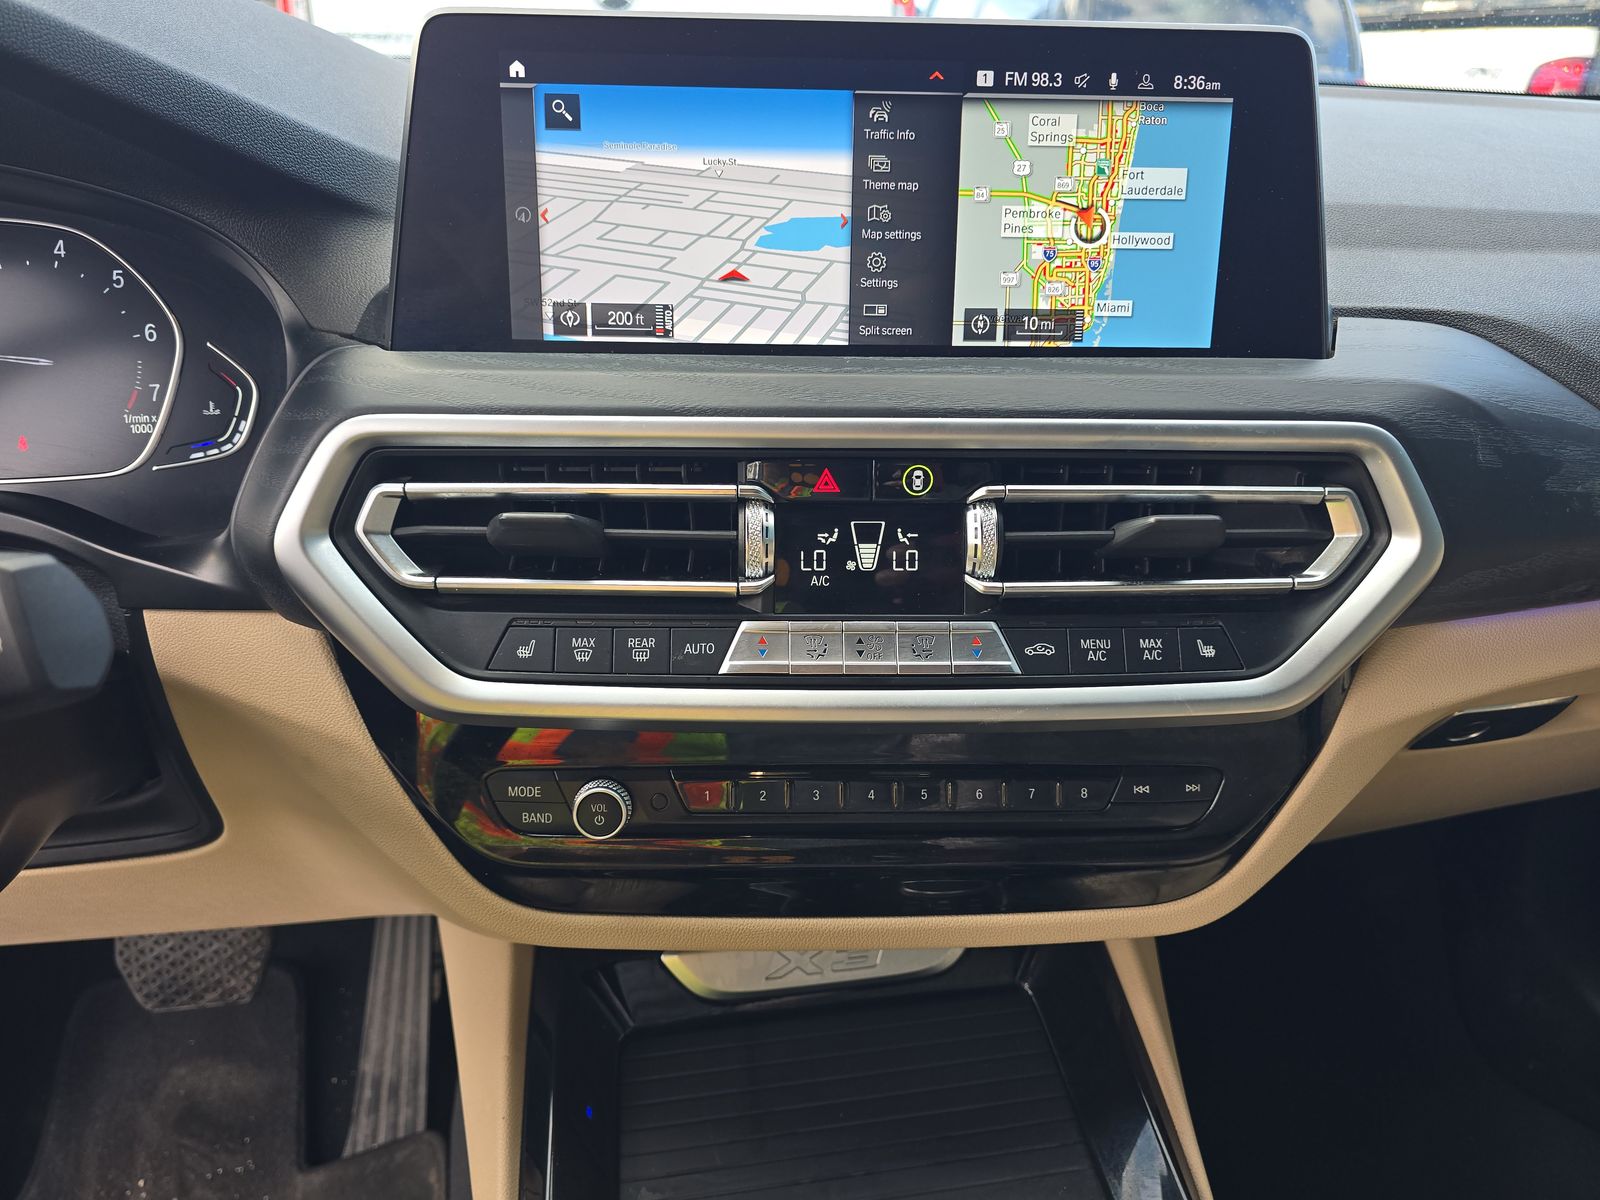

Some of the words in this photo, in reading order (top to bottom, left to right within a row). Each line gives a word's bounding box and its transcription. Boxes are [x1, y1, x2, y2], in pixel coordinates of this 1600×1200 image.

[1005, 72, 1027, 86] FM
[1031, 72, 1062, 87] 98.3
[1173, 75, 1221, 91] 8:36am
[1140, 102, 1164, 111] Boca
[1031, 115, 1061, 127] Coral
[1139, 115, 1168, 125] Raton
[863, 128, 895, 140] Traffic
[896, 129, 916, 140] Info
[1030, 131, 1074, 144] Springs
[702, 157, 727, 167] Lucky
[728, 157, 737, 166] St
[1016, 164, 1027, 172] 27
[1122, 170, 1145, 180] Fort
[863, 179, 896, 190] Theme
[897, 181, 919, 192] map
[1121, 185, 1184, 196] Lauderdale
[1004, 208, 1061, 219] Pembroke
[1003, 222, 1034, 234] Pines
[861, 229, 883, 240] Map
[884, 229, 922, 241] settings
[1112, 235, 1171, 247] Hollywood
[53, 240, 66, 258] 4
[112, 270, 125, 289] 5
[860, 277, 899, 289] Settings
[1002, 276, 1015, 284] 997
[1096, 302, 1130, 312] Miami
[608, 311, 633, 326] 200
[635, 313, 645, 326] ft
[664, 310, 673, 330] AUTO
[1022, 317, 1038, 331] 10
[1040, 320, 1055, 331] mi
[144, 323, 158, 342] 6
[859, 325, 880, 336] Split
[881, 326, 913, 336] screen
[149, 384, 161, 402] 7
[123, 414, 149, 424] 1/min
[130, 424, 153, 434] 1000
[800, 549, 827, 571] LO
[892, 549, 919, 571] LO
[810, 575, 830, 587] A/C
[571, 637, 596, 648] MAX
[628, 637, 656, 648] REAR
[1080, 638, 1111, 649] MENU
[1139, 638, 1163, 649] MAX
[684, 643, 715, 655] AUTO
[866, 652, 884, 661] OFF
[1087, 650, 1107, 661] A/C
[1143, 650, 1163, 661] A/C
[507, 786, 542, 798] MODE
[704, 790, 710, 801] 1
[759, 790, 767, 801] 2
[812, 789, 820, 801] 3
[867, 789, 876, 801] 4
[920, 788, 928, 800] 5
[975, 788, 983, 800] 6
[1028, 788, 1036, 800] 7
[1080, 787, 1088, 799] 8
[590, 803, 608, 813] VOL
[521, 812, 553, 823] BAND
